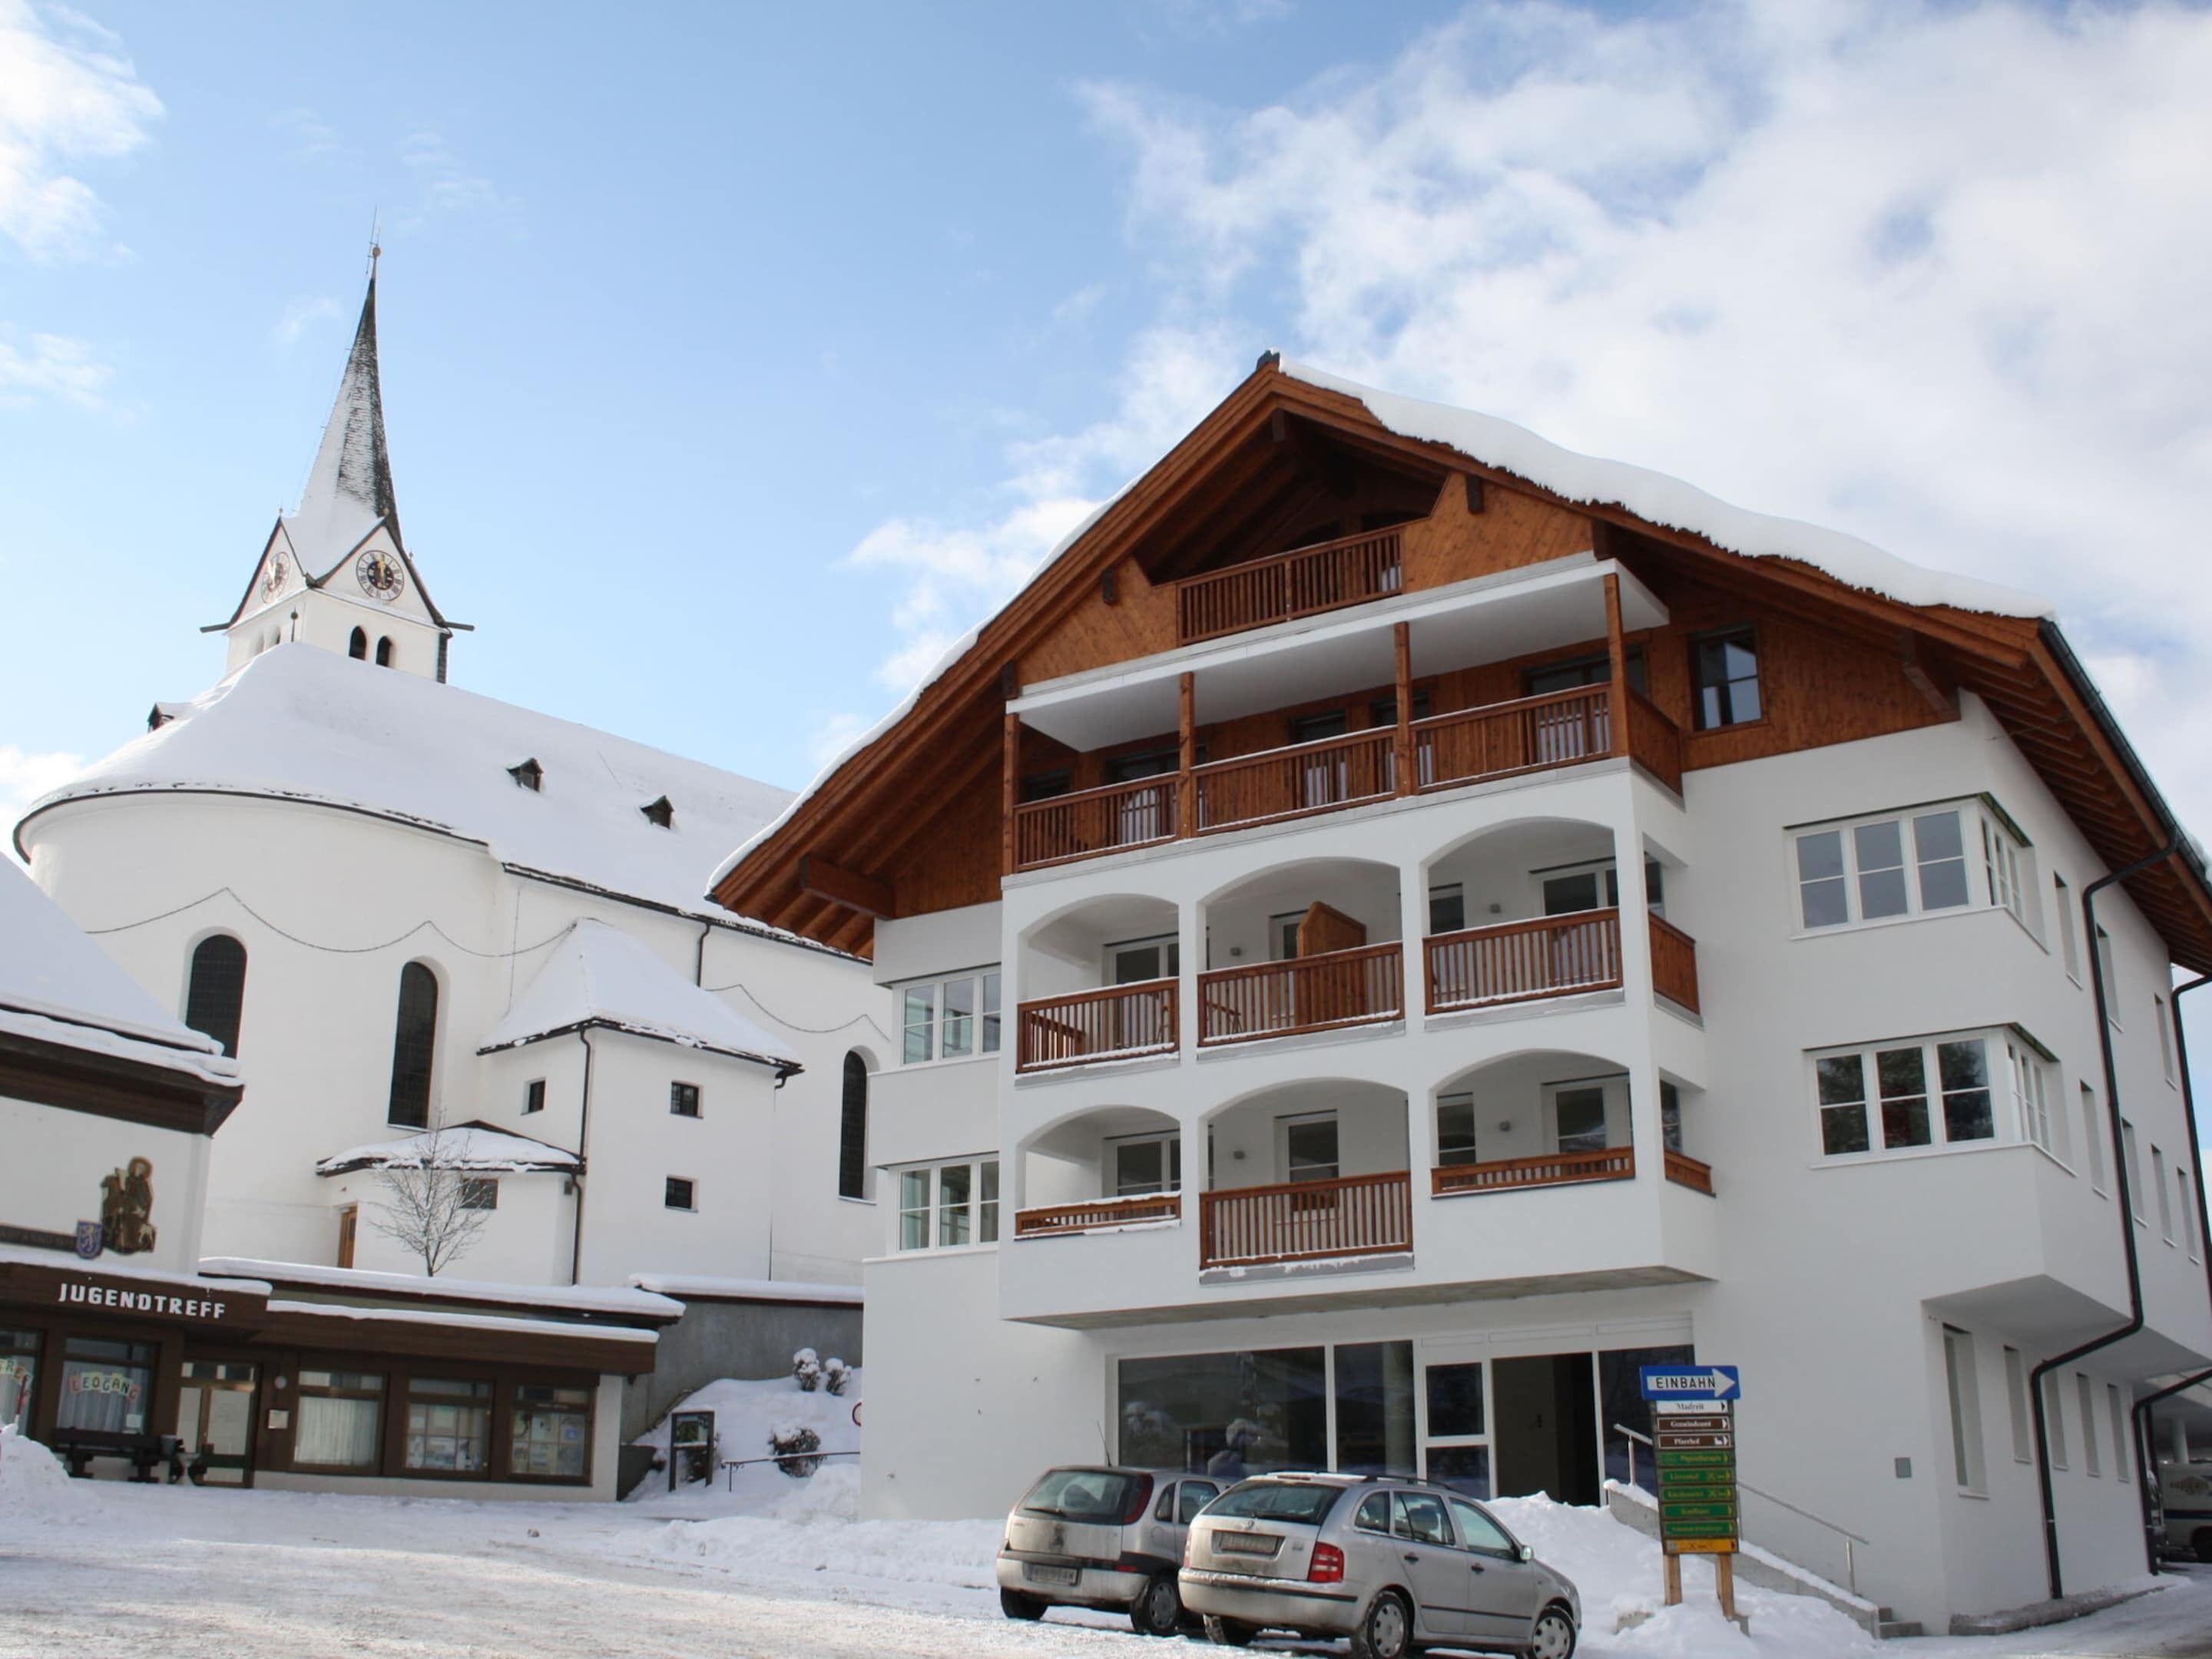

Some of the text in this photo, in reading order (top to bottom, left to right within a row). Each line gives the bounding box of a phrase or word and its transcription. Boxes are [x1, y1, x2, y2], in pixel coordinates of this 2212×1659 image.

[58, 1283, 226, 1319] JUGENDTREFF
[71, 1376, 139, 1400] LEOGANG
[1656, 1377, 1716, 1389] EINBAHN
